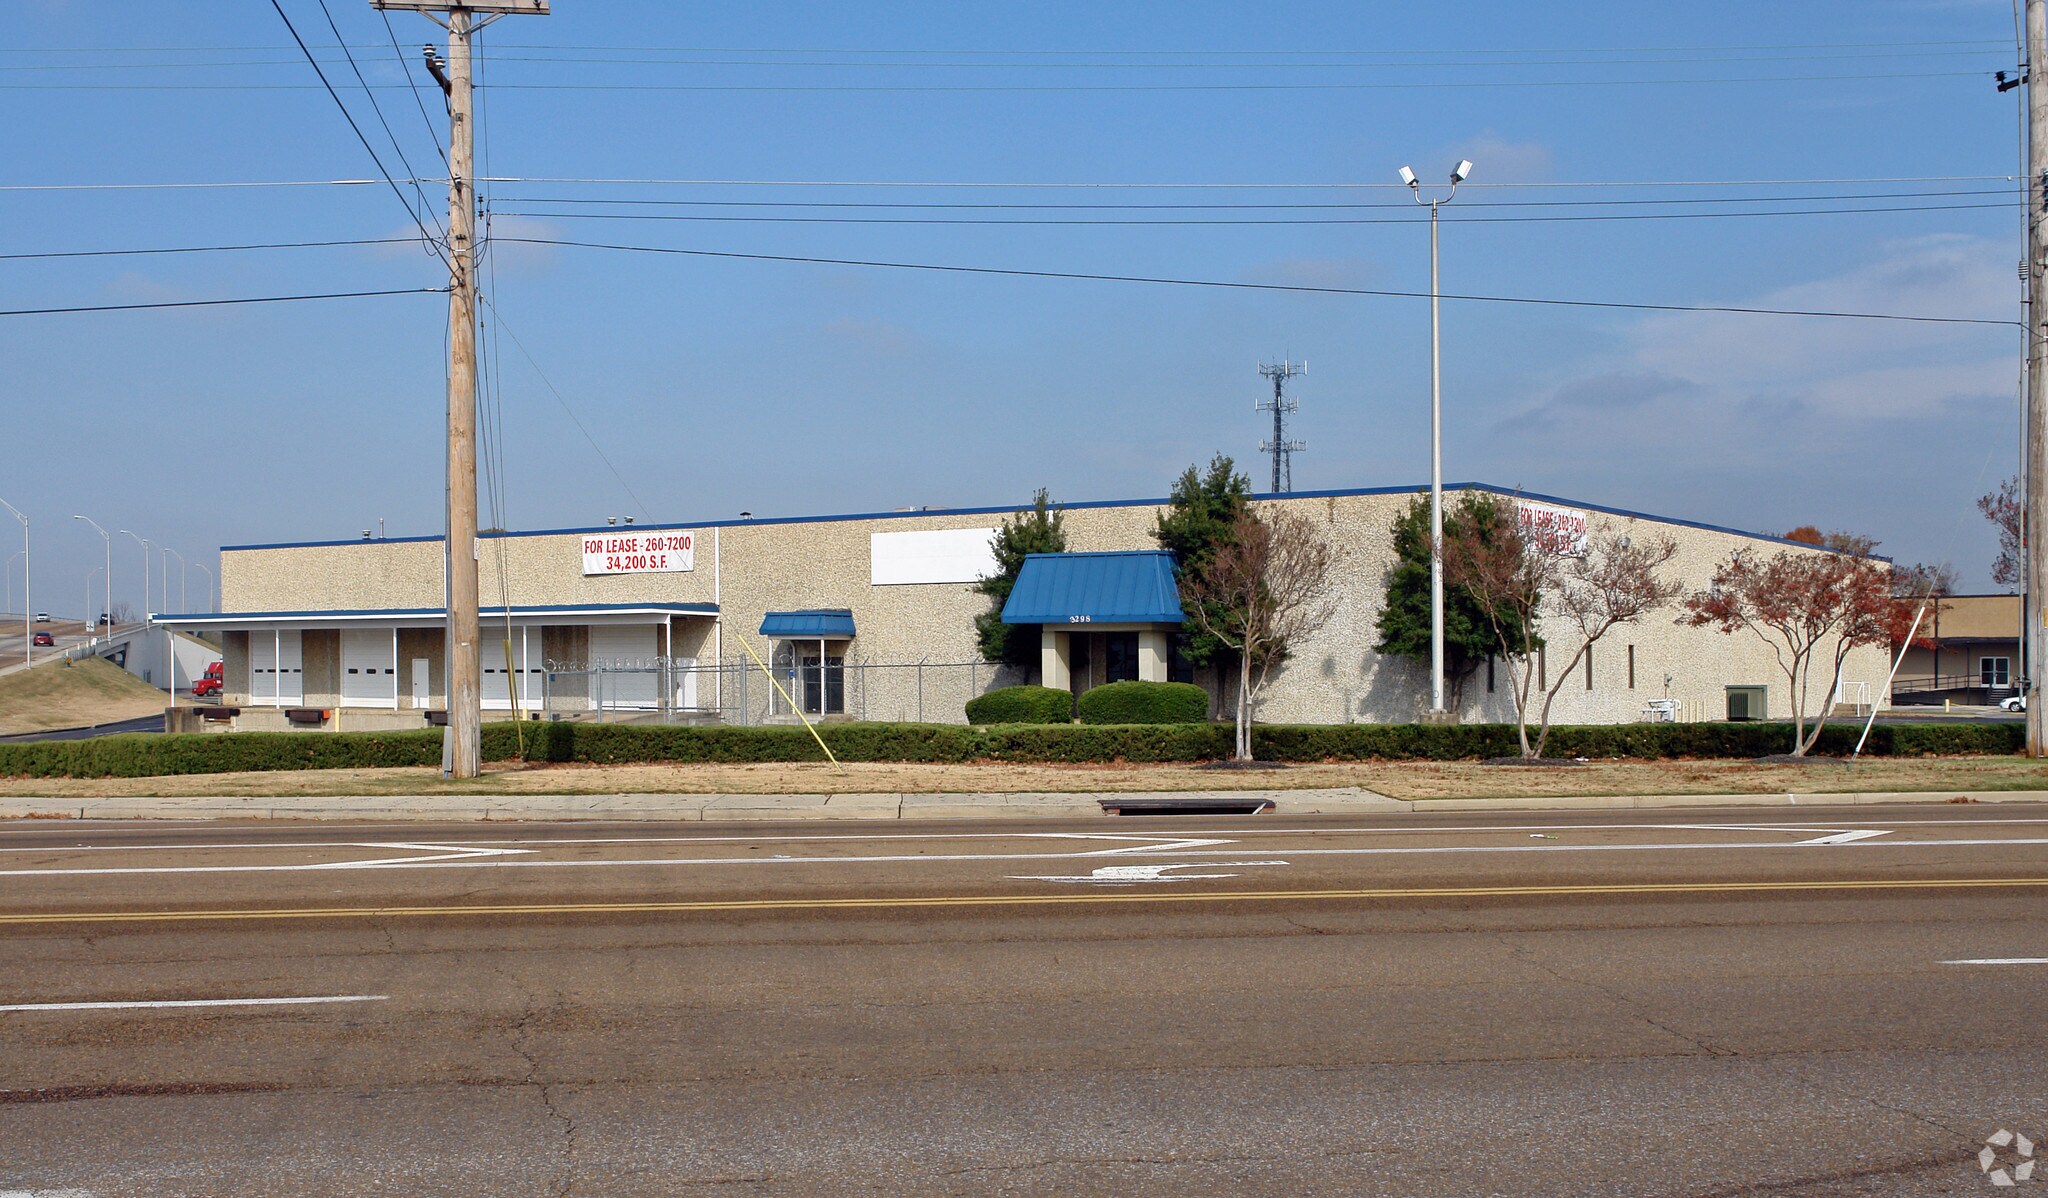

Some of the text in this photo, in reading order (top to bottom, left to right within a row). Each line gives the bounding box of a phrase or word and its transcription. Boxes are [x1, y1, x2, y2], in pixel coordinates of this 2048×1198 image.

[584, 540, 603, 554] FOR
[606, 539, 637, 553] LEASE
[645, 536, 691, 552] 260-7200
[606, 555, 668, 571] 34,200 S.F.
